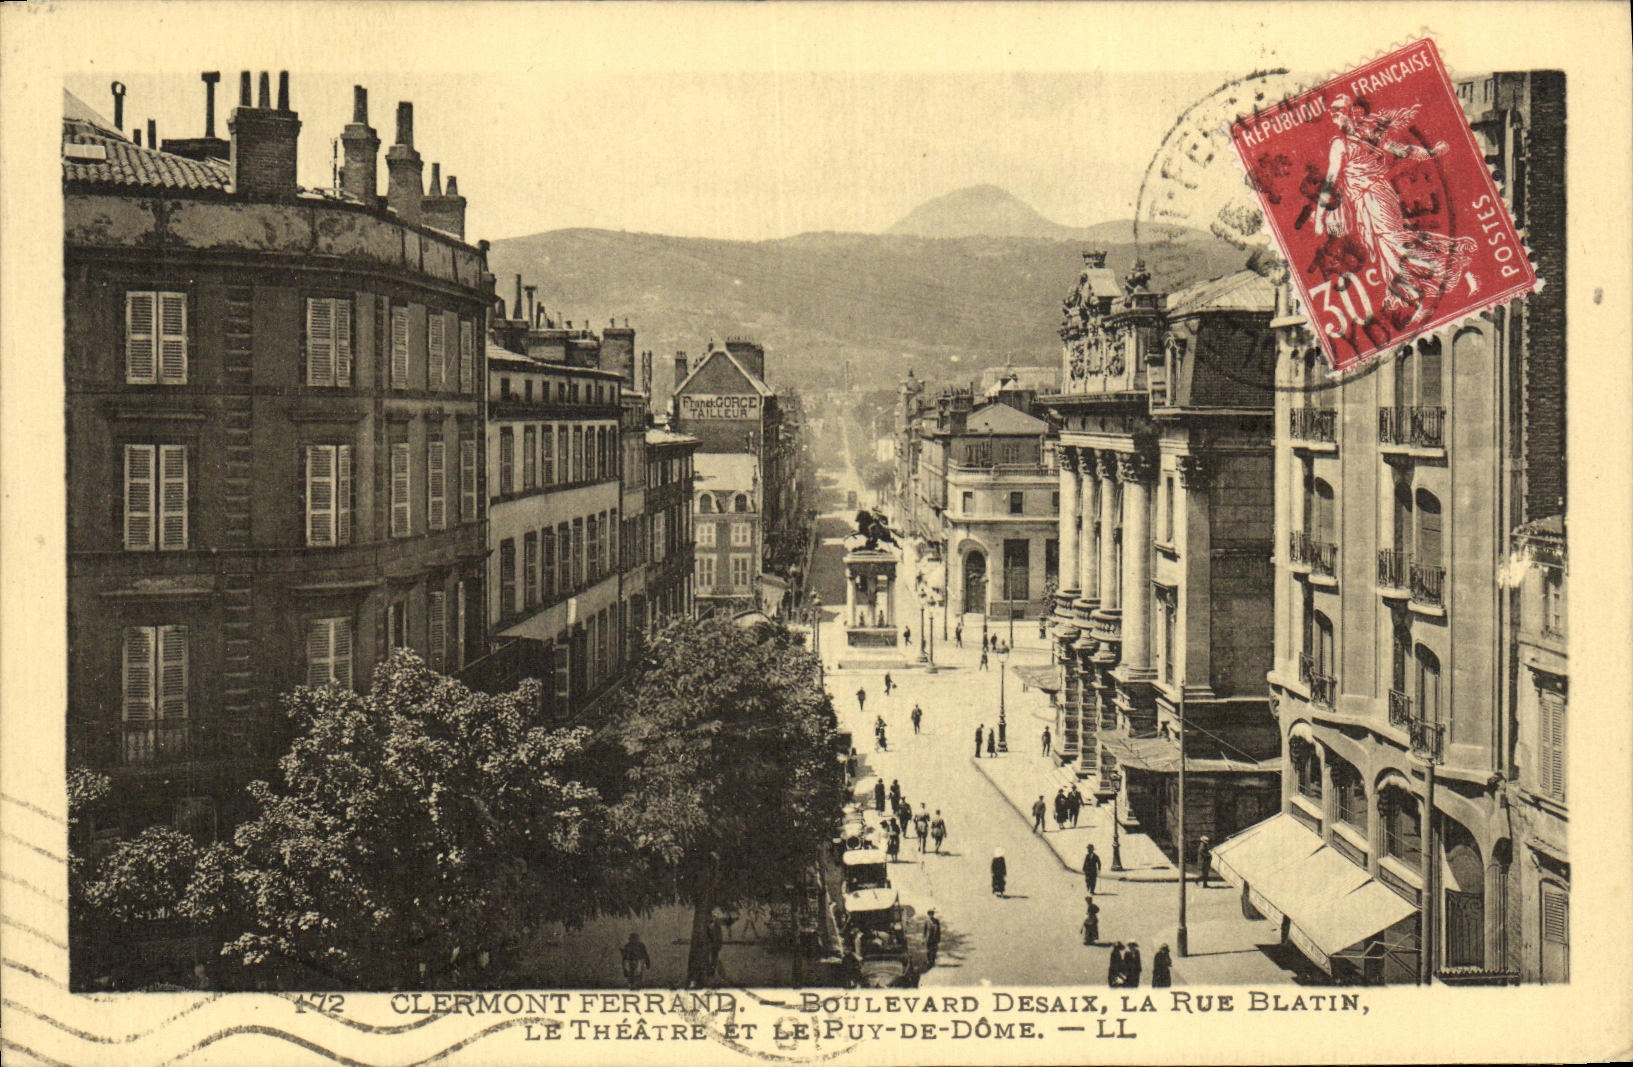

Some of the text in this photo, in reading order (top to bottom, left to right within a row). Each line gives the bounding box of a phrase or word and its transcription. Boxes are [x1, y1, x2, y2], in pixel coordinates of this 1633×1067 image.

[1351, 50, 1433, 97] FRANÇAISE
[1471, 194, 1521, 278] POSTES
[689, 408, 748, 418] TAILLEUR
[716, 396, 757, 408] GORCE
